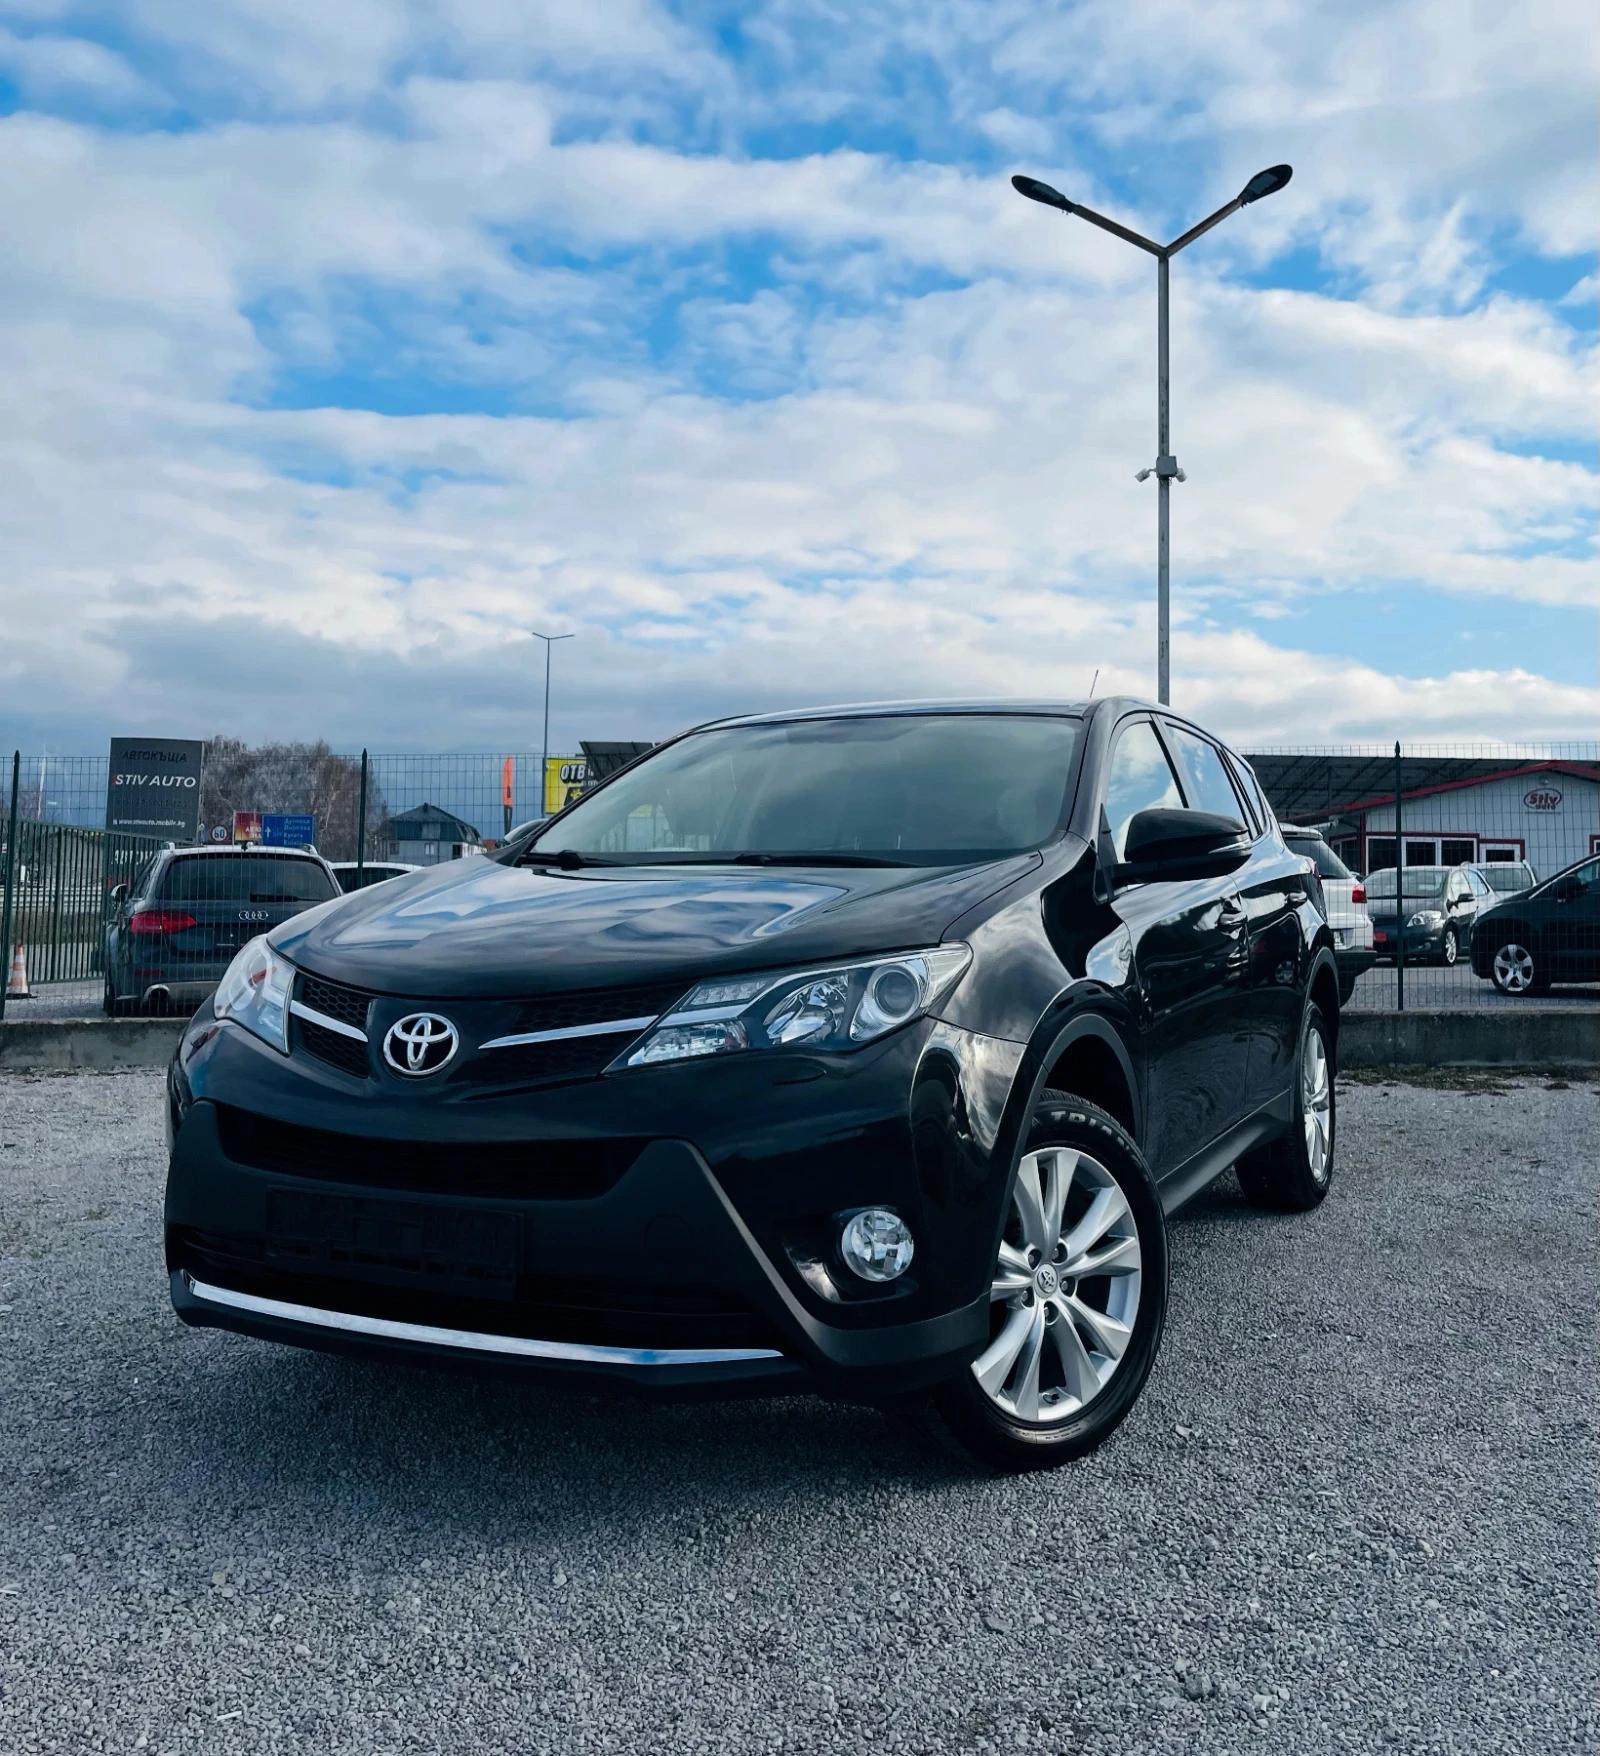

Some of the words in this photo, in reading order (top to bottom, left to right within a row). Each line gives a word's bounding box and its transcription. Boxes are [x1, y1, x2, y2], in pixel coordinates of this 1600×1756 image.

[122, 750, 187, 763] АВТОКЪЩА
[115, 774, 148, 785] STIV
[149, 775, 196, 788] AUTO
[214, 829, 225, 839] 60
